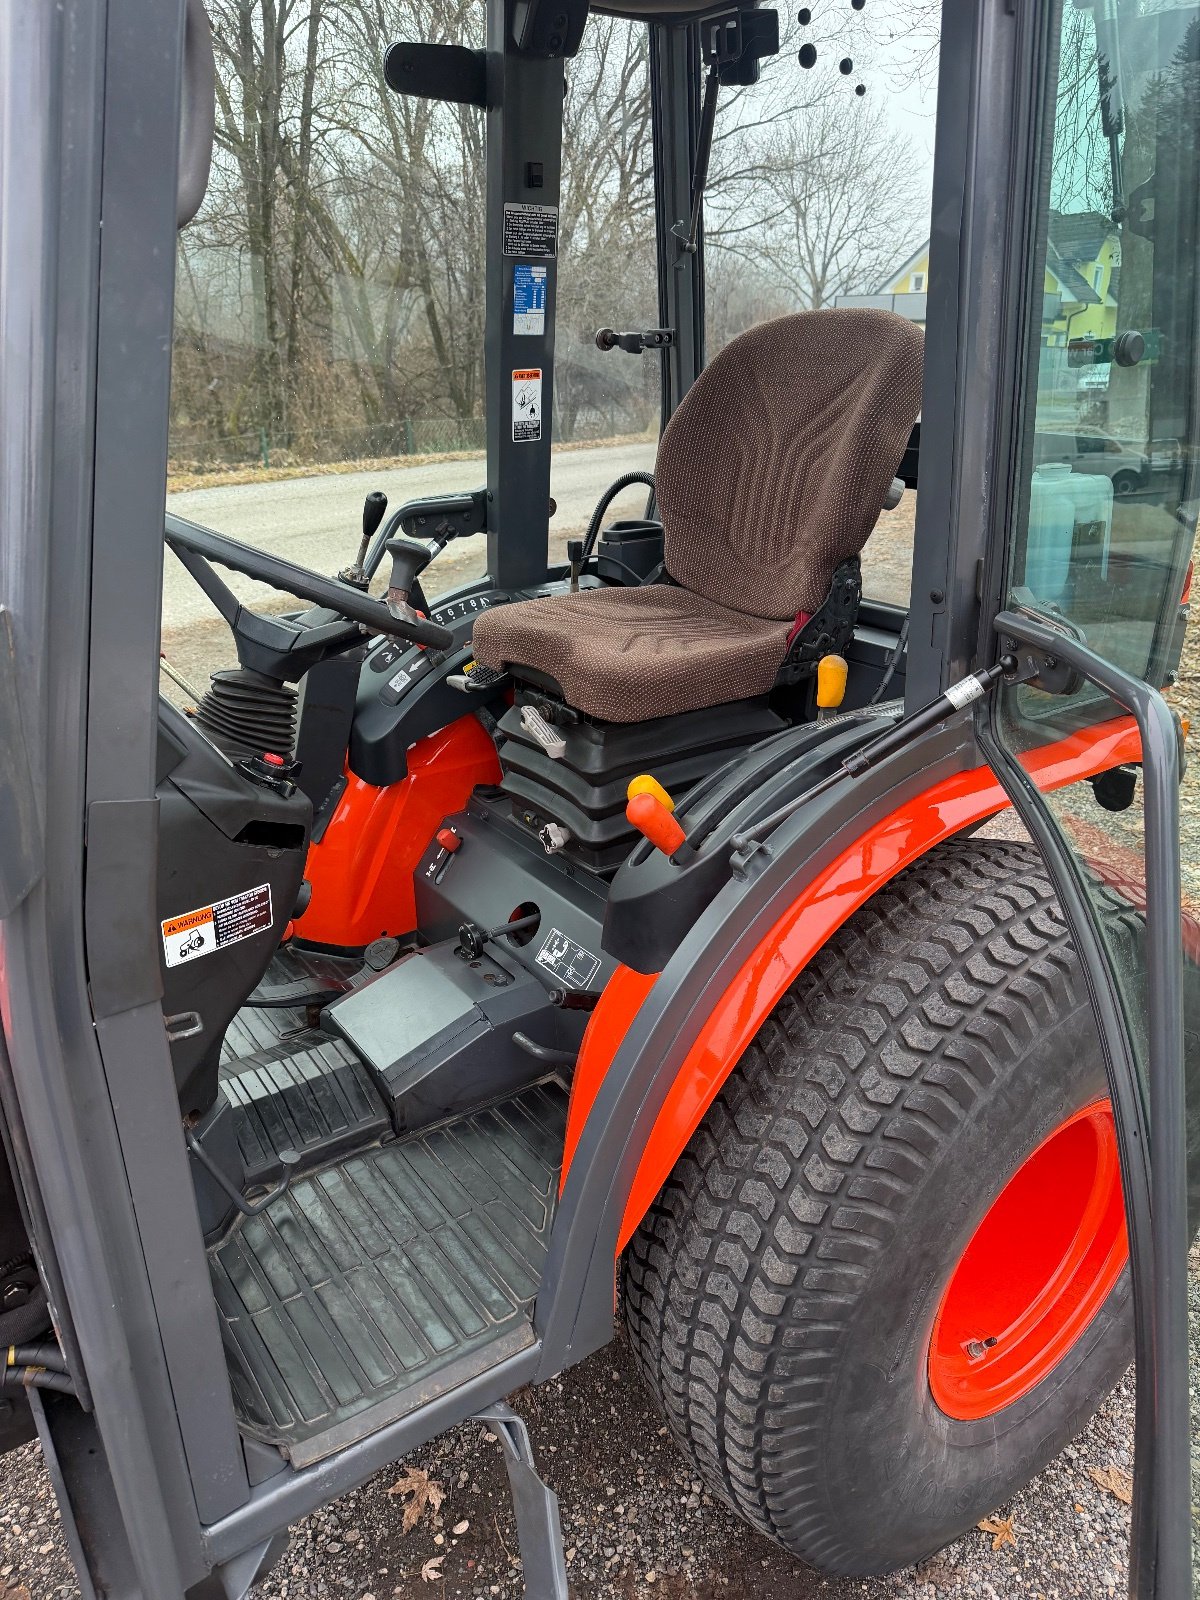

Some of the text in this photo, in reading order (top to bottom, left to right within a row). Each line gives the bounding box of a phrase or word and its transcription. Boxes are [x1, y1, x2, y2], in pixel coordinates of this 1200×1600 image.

[435, 599, 477, 622] 5 6 7 8
[177, 911, 212, 929] WARNUNG
